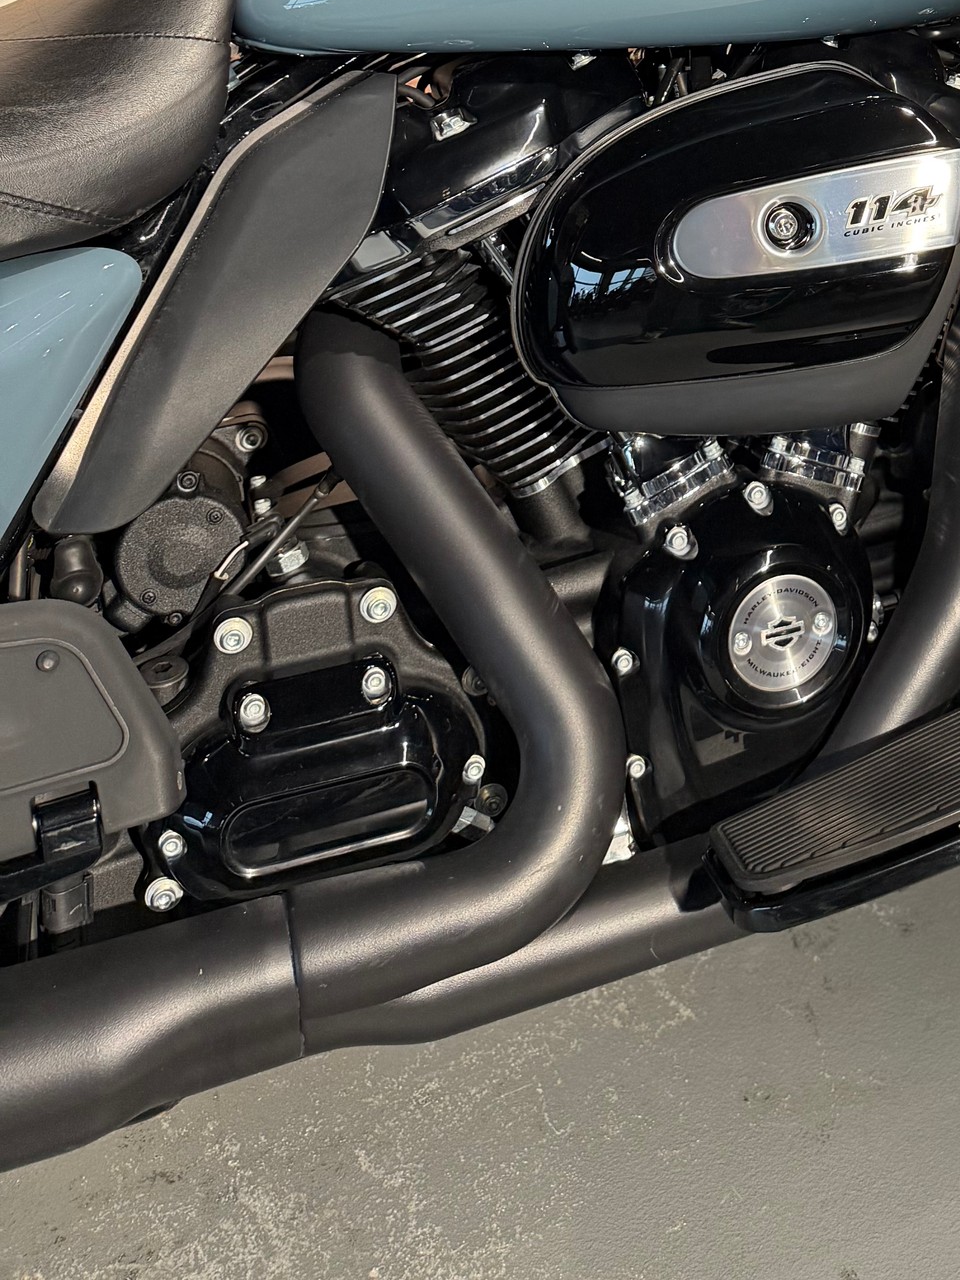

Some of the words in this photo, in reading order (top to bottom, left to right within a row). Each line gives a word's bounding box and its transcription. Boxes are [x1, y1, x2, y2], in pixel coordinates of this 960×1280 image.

[843, 223, 885, 238] CUBIC
[890, 214, 936, 229] INCHES
[845, 185, 944, 230] 114
[746, 638, 822, 678] MILWAUKE-EIGHT
